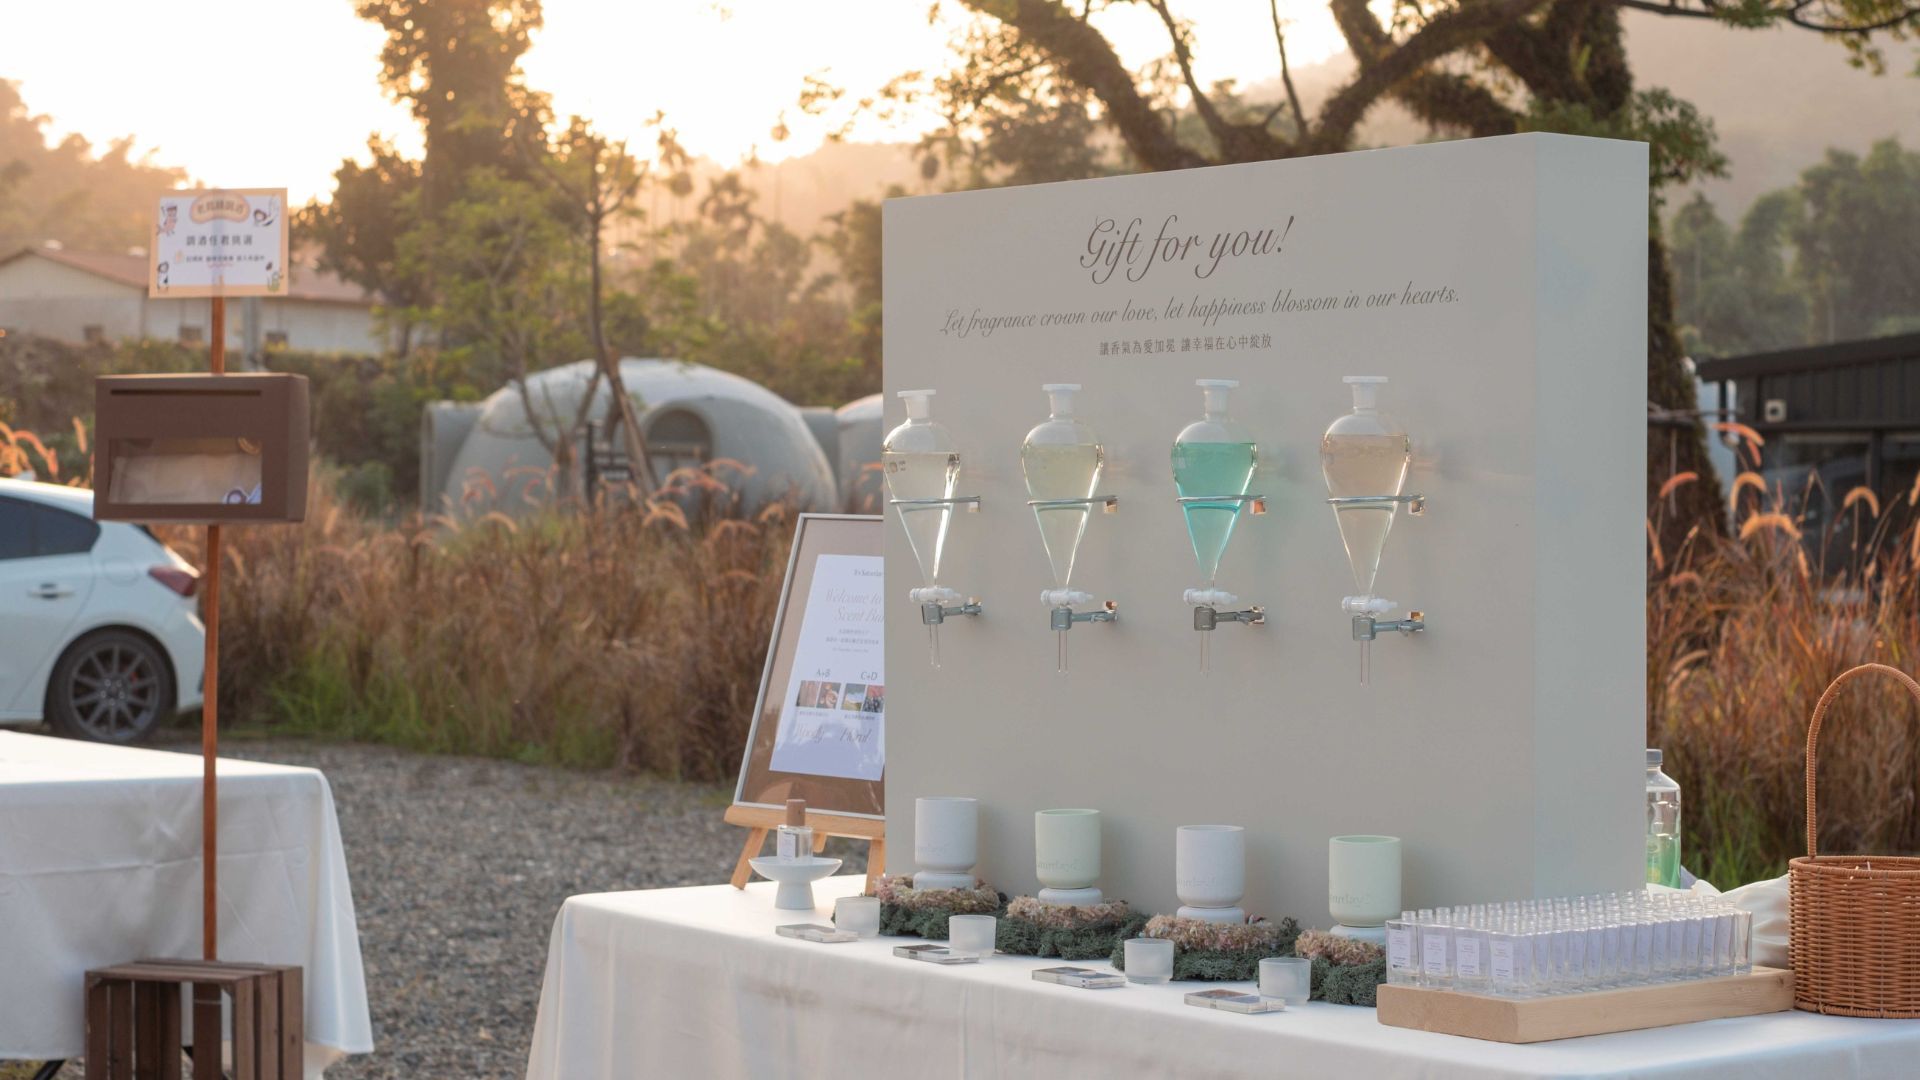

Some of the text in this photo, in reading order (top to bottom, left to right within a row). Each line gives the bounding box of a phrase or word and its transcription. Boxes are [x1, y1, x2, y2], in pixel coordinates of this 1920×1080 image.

[1080, 214, 1295, 285] Gift for you!
[940, 280, 1459, 339] Let fragrance crown our love, let happiness blossom in our hearts.
[1180, 332, 1273, 352] 讓幸福在心中綻放
[860, 671, 878, 681] C+D
